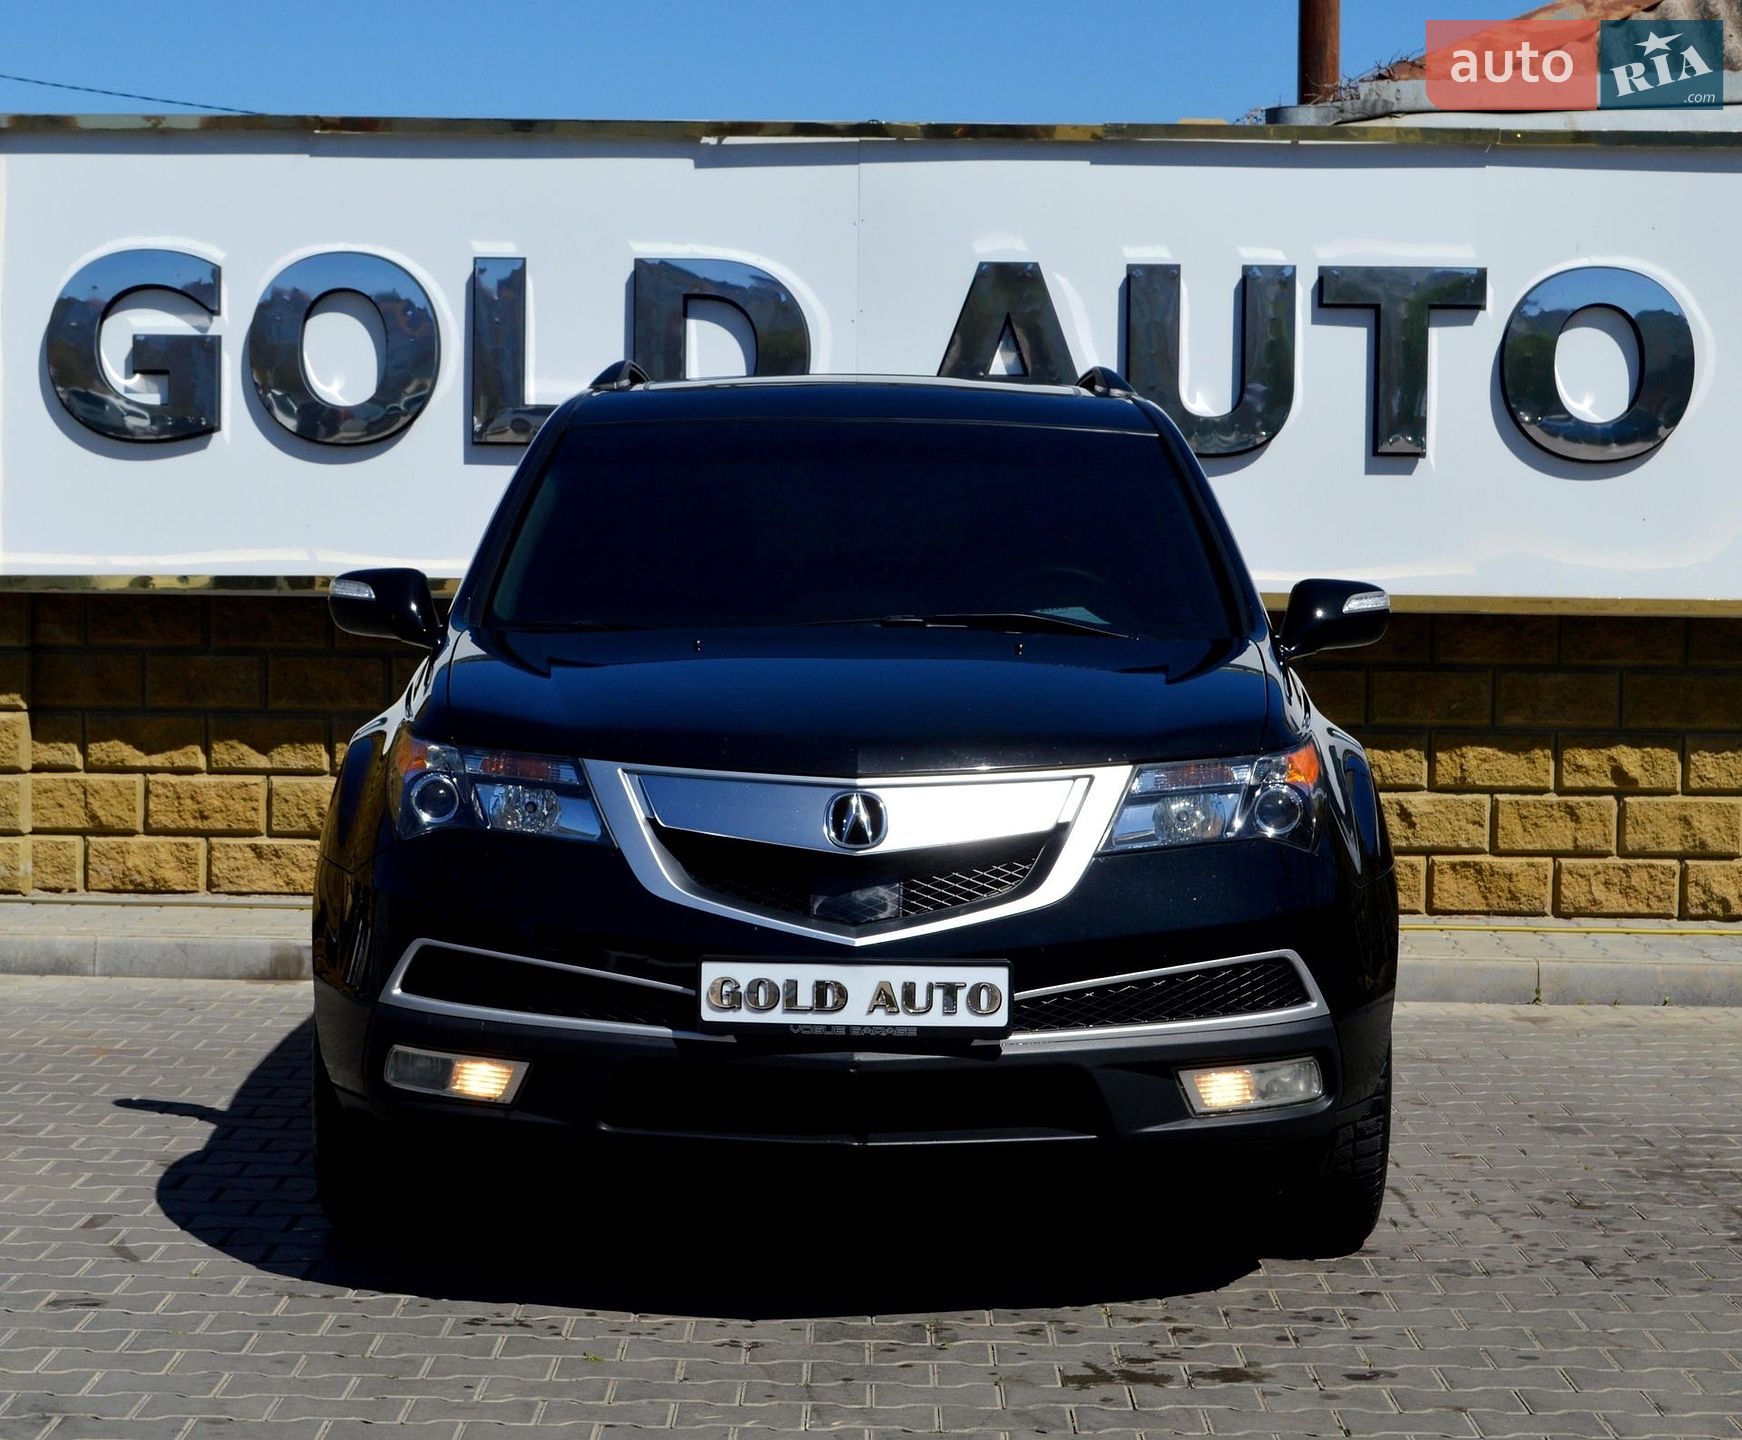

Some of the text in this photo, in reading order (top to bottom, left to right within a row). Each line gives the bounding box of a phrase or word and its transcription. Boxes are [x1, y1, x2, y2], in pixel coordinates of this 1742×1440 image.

[46, 248, 812, 446] GOLD
[707, 975, 1003, 1015] GOLD AUTO
[789, 1024, 846, 1036] VOGUE
